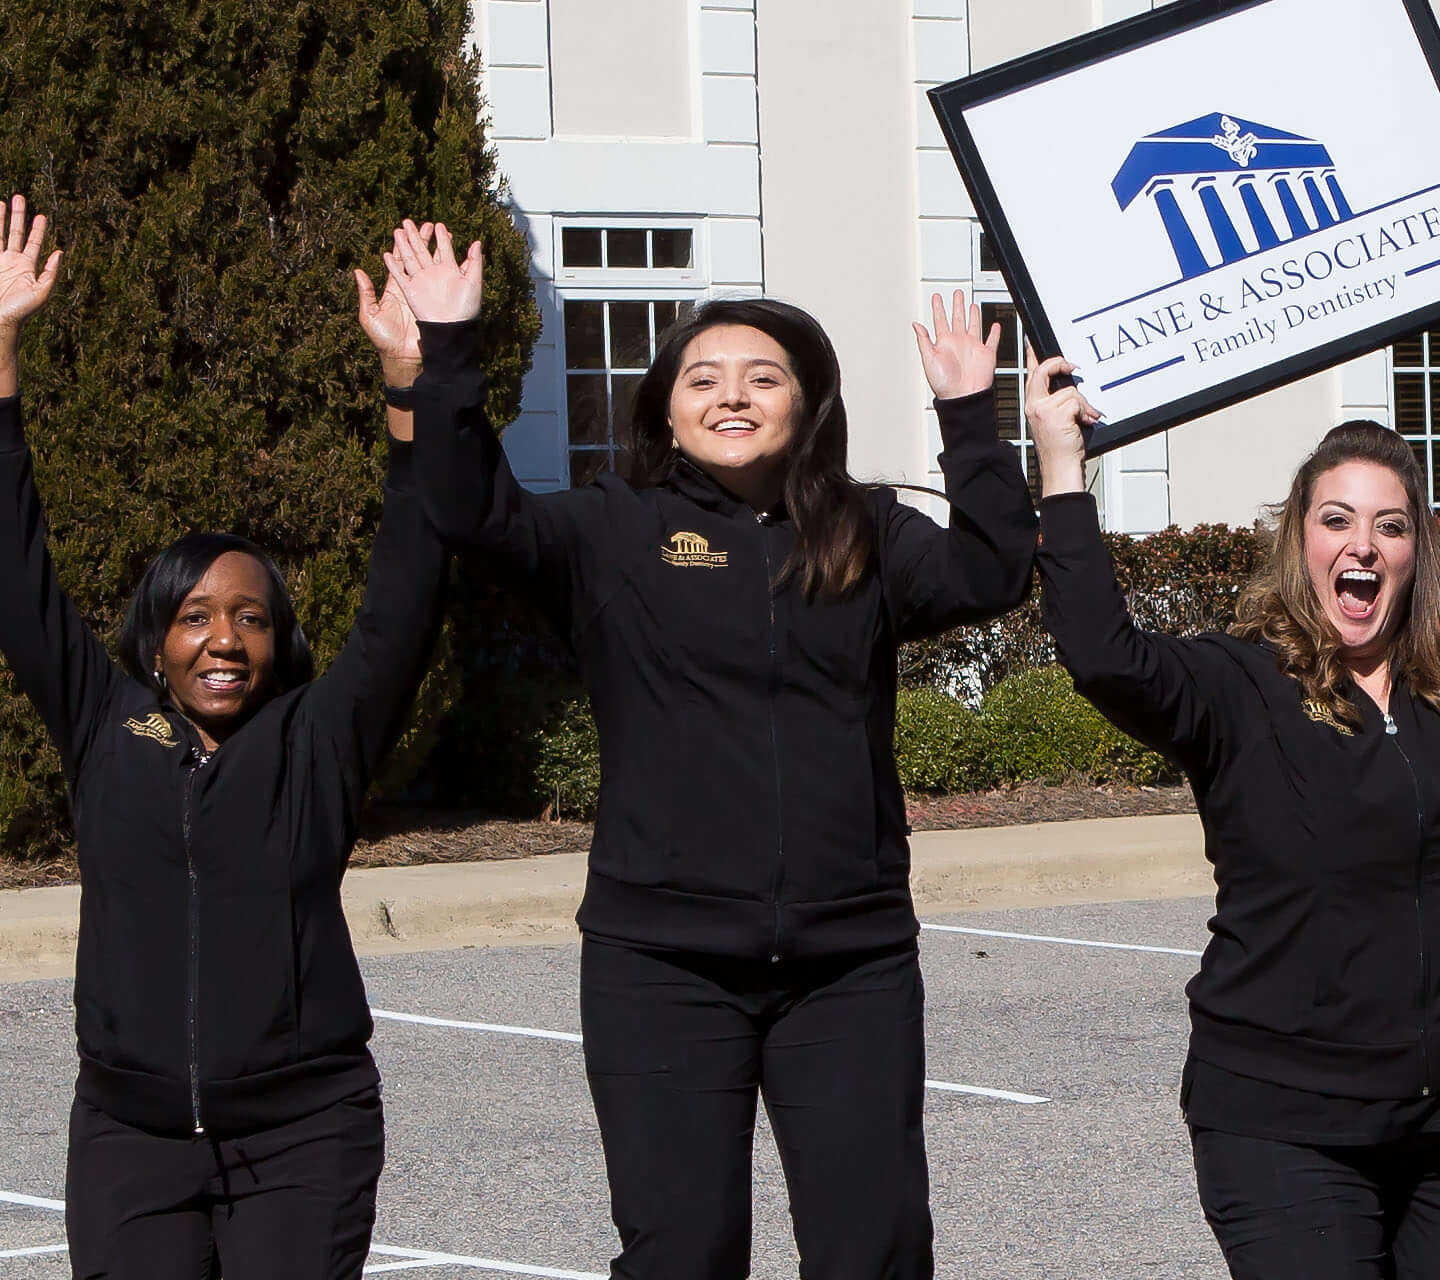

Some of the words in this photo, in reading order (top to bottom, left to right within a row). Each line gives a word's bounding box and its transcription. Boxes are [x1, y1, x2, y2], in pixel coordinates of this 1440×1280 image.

[1086, 301, 1193, 364] LANE
[1200, 293, 1232, 320] &
[1191, 318, 1276, 363] Family
[1282, 274, 1396, 329] Dentistry
